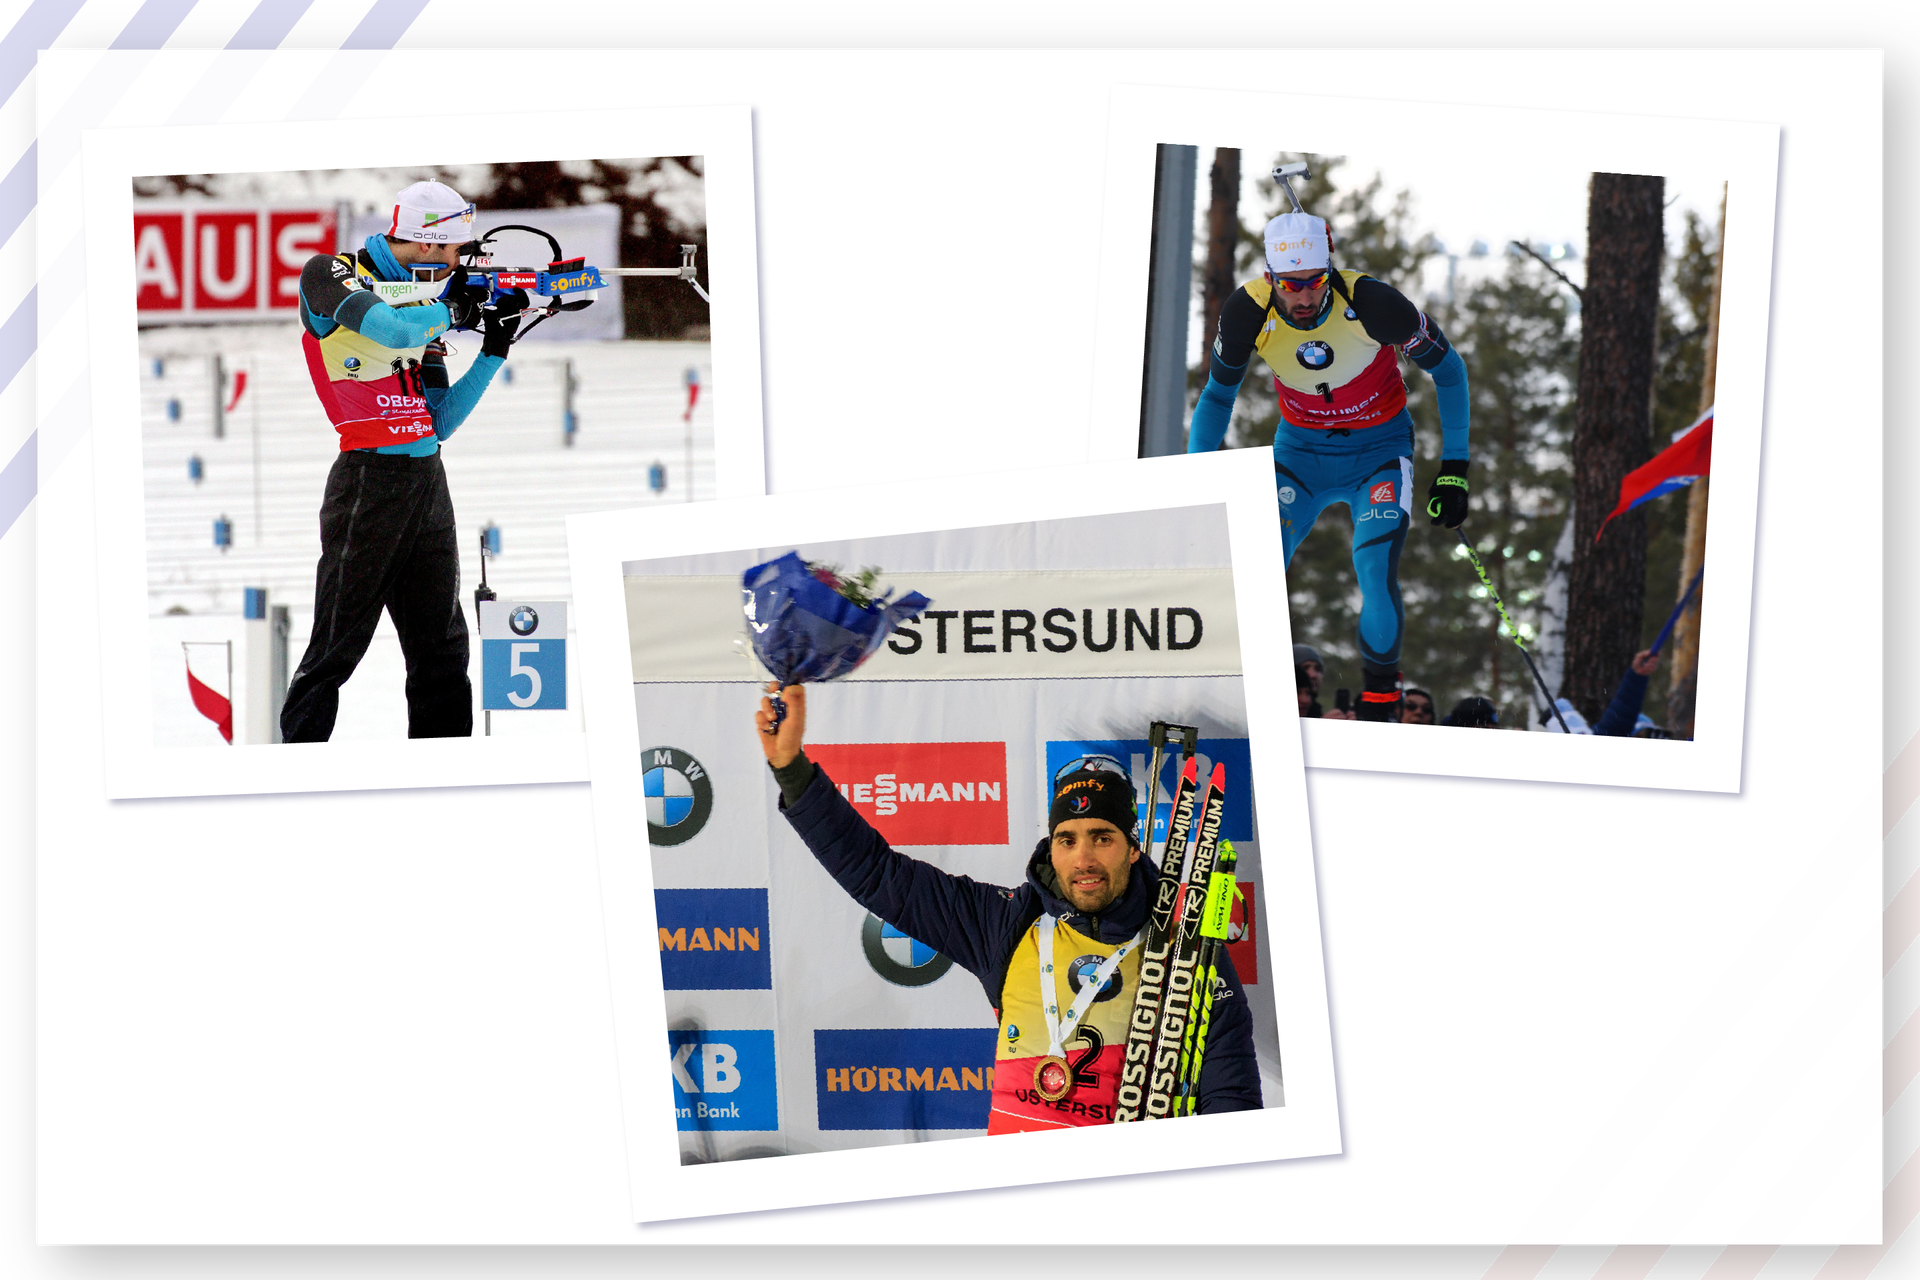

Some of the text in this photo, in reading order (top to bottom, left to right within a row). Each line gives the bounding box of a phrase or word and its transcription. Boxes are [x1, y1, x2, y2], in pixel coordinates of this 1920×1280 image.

[413, 232, 448, 240] odlo
[1274, 238, 1314, 252] somfy
[135, 222, 327, 299] AUS
[498, 275, 536, 286] VIESSMANN
[381, 284, 412, 298] mgen
[1315, 382, 1334, 403] 1
[888, 607, 1203, 655] STERSUND
[507, 643, 542, 708] 5
[834, 773, 1001, 815] IESSMANN
[1056, 778, 1105, 799] somfy
[1163, 790, 1196, 876] PREMIUM
[1191, 798, 1224, 884] PREMIUM
[659, 927, 760, 952] MANN
[1213, 989, 1234, 1001] dlo
[1114, 942, 1169, 1123] ROSSIGNOL
[1144, 950, 1198, 1121] OSSIGNOL
[669, 1043, 742, 1094] KB
[1072, 1024, 1105, 1089] 2
[697, 1101, 740, 1118] Bank
